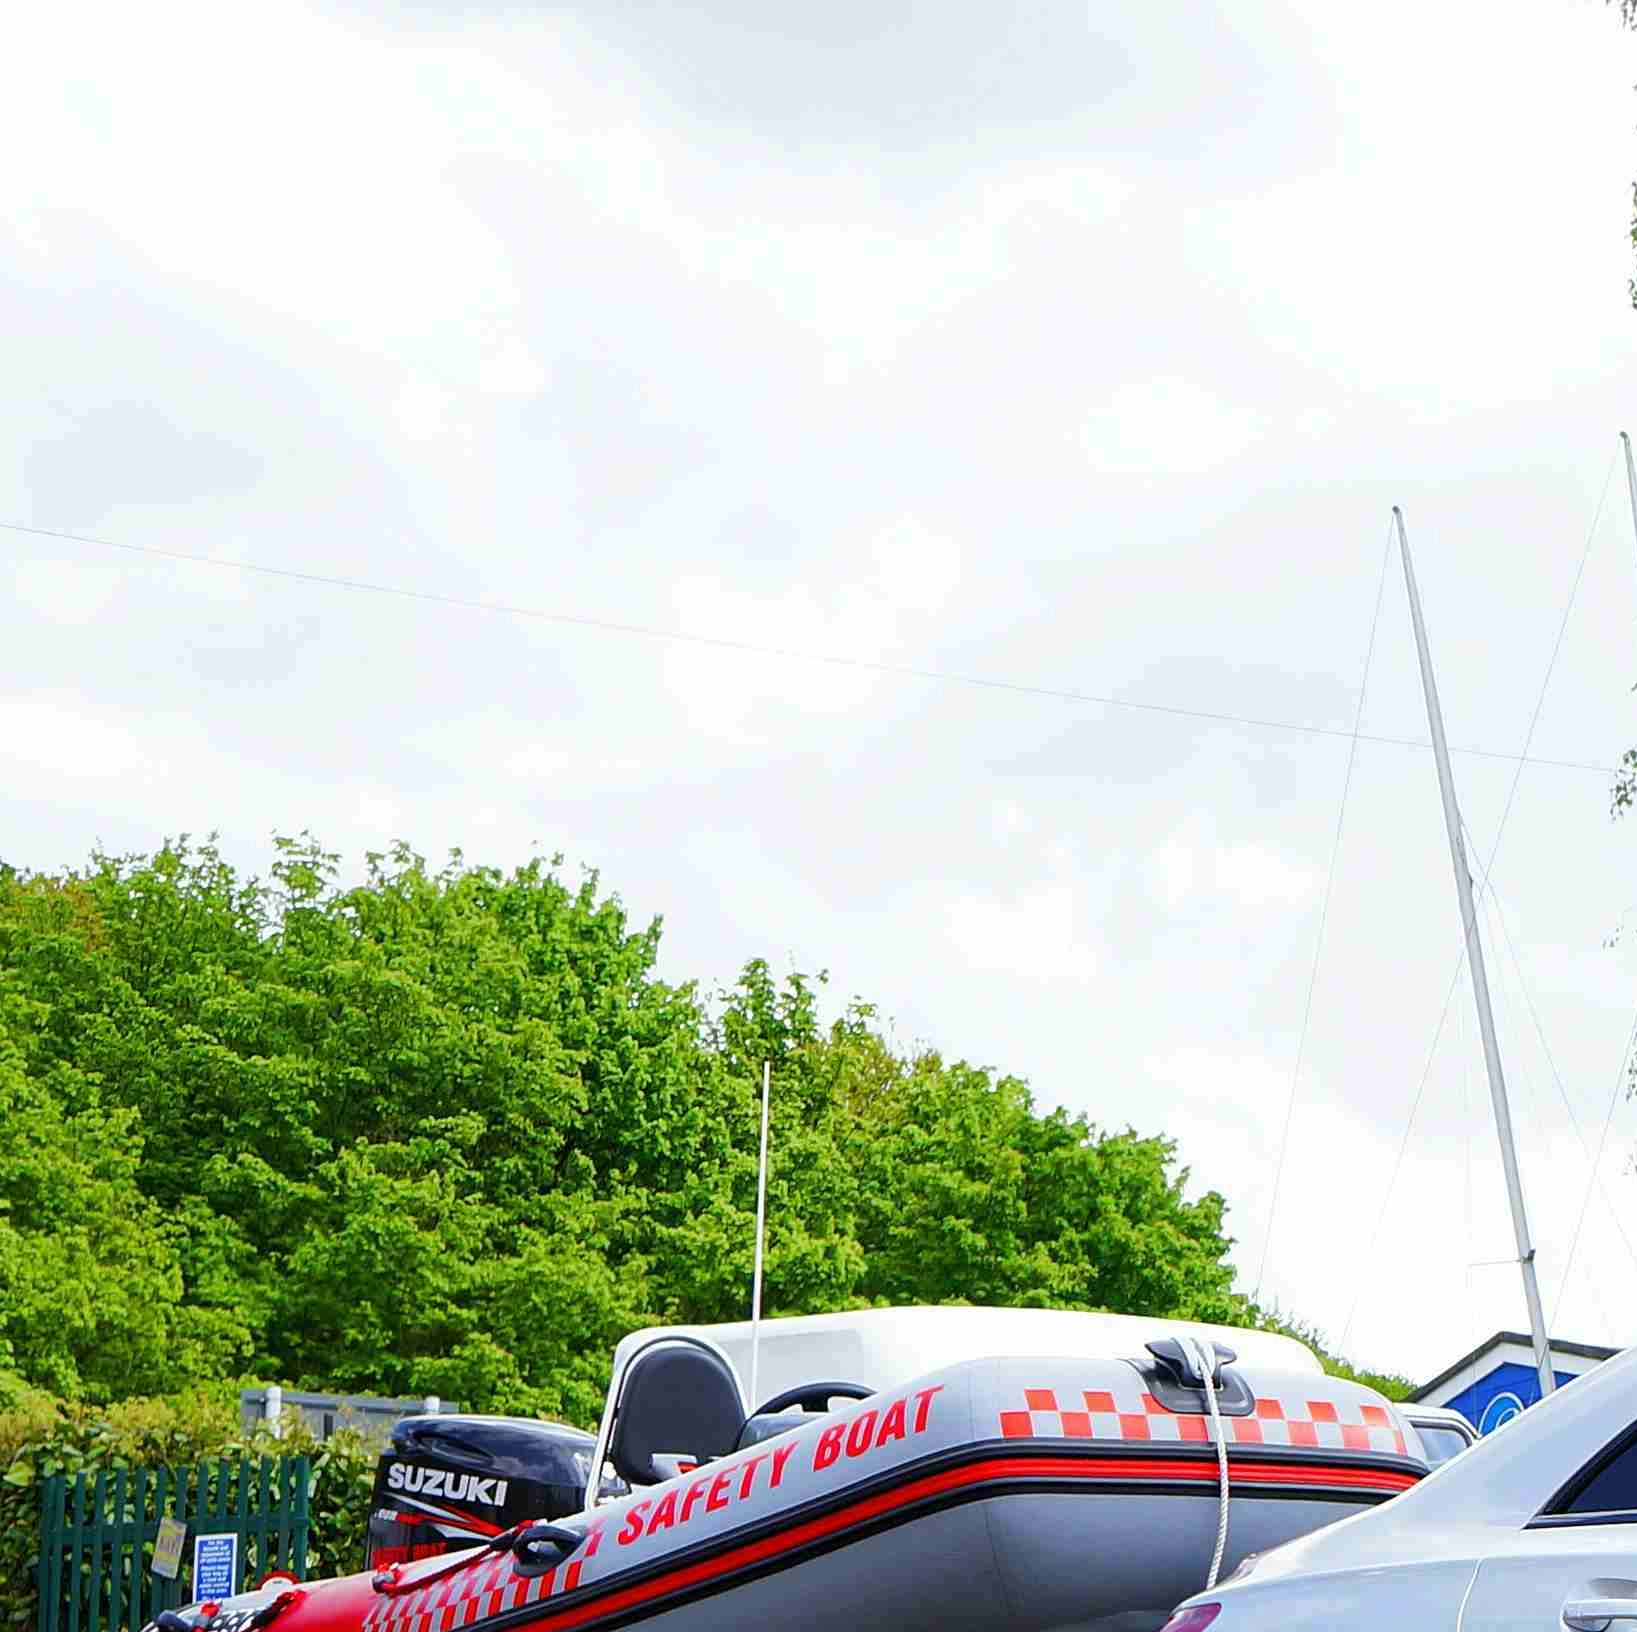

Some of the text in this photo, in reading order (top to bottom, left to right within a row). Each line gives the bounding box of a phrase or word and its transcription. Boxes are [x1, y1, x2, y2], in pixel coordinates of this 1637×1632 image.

[387, 1462, 509, 1507] SUZUKI
[616, 1384, 944, 1546] SAFETY BOAT
